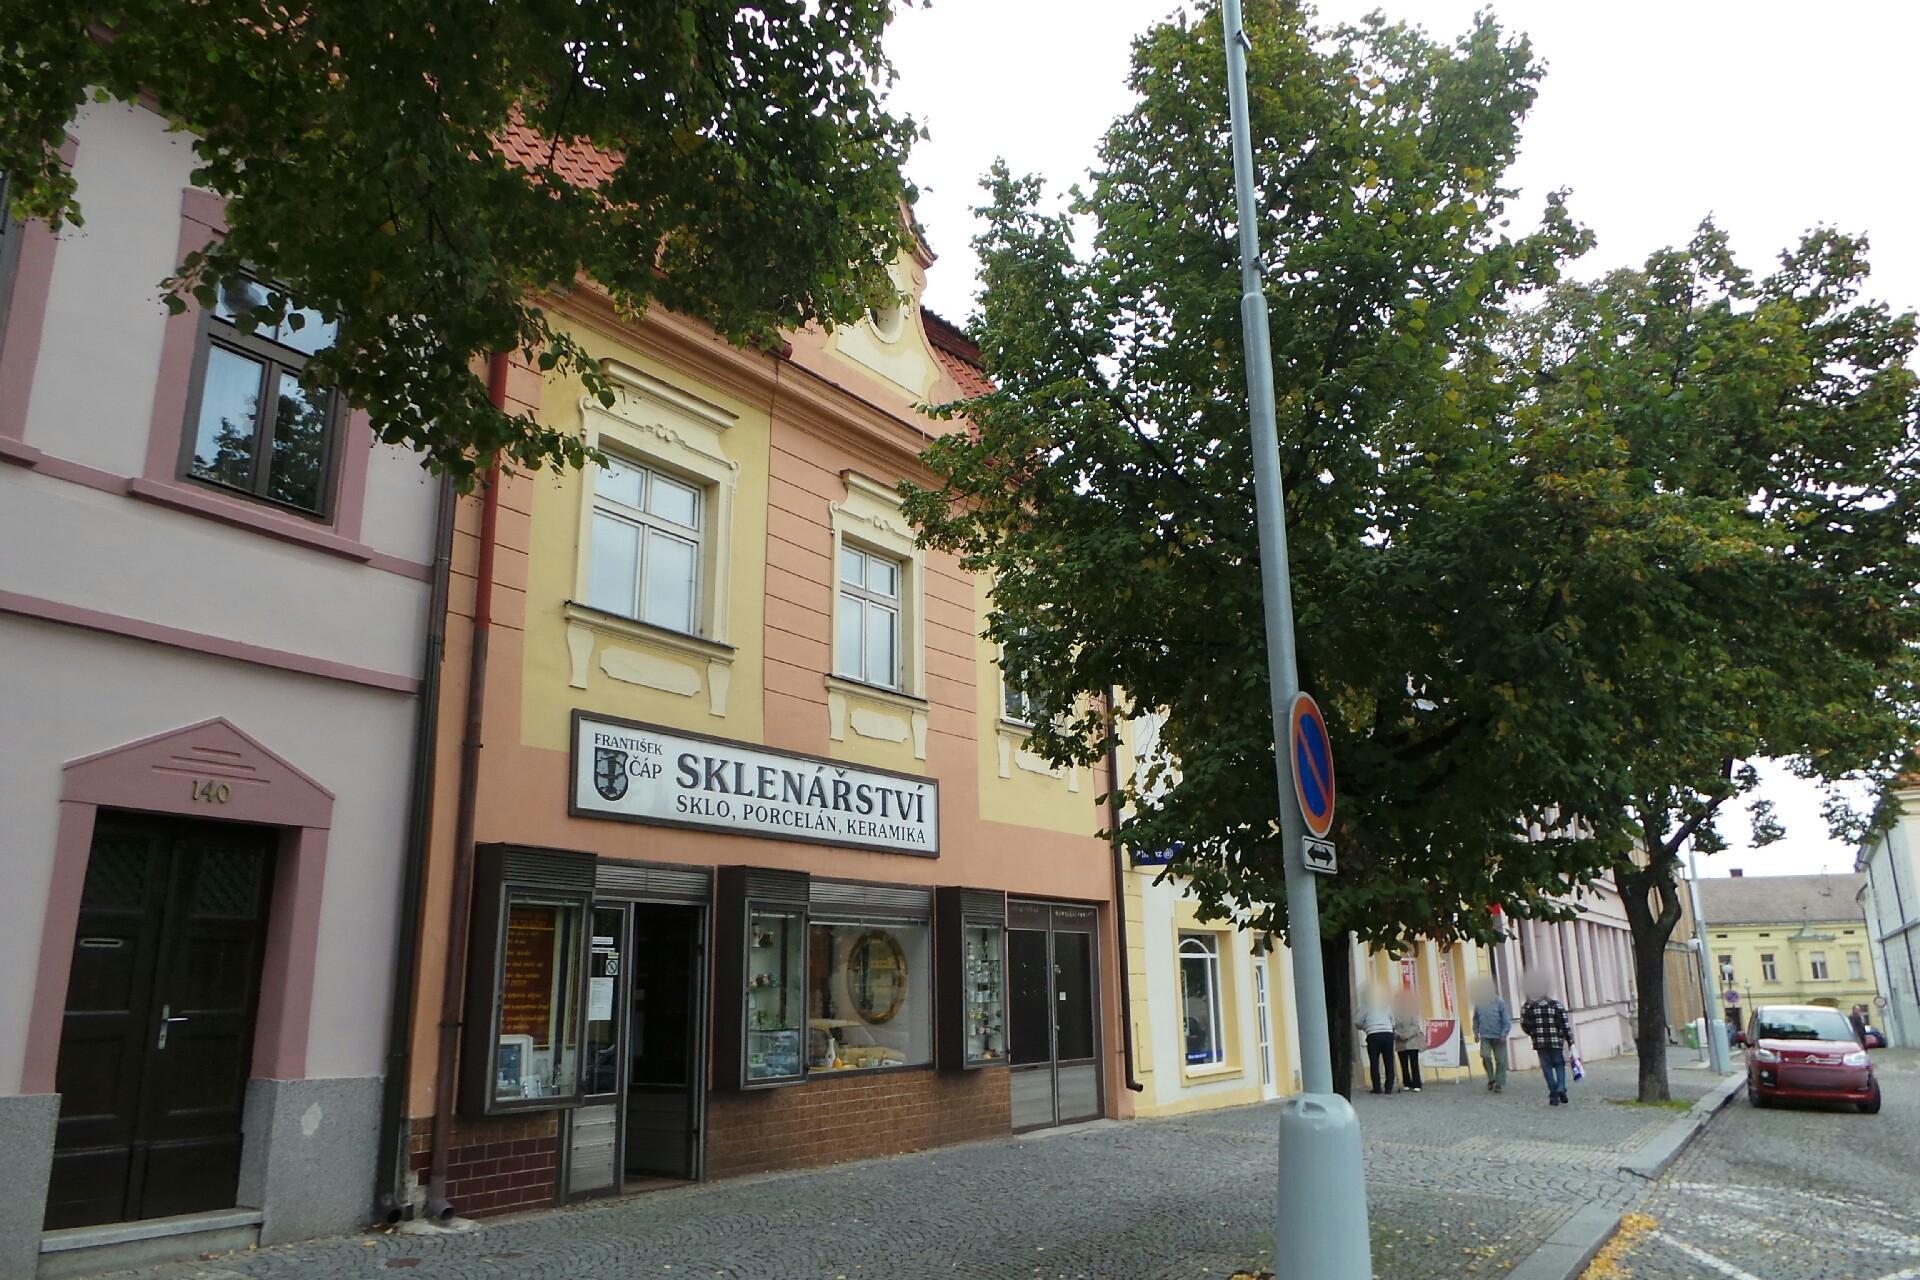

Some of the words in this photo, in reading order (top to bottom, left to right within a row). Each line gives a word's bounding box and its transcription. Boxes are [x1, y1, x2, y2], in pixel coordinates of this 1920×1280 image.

[594, 732, 663, 756] FRANTIŠEK
[629, 755, 663, 780] ČÁP
[192, 780, 231, 804] 140
[675, 752, 925, 824] SKLENÁŘSTVÍ
[676, 794, 737, 822] SKLO,
[743, 803, 843, 836] PORCELÁN,
[847, 818, 926, 845] KERAMIKA
